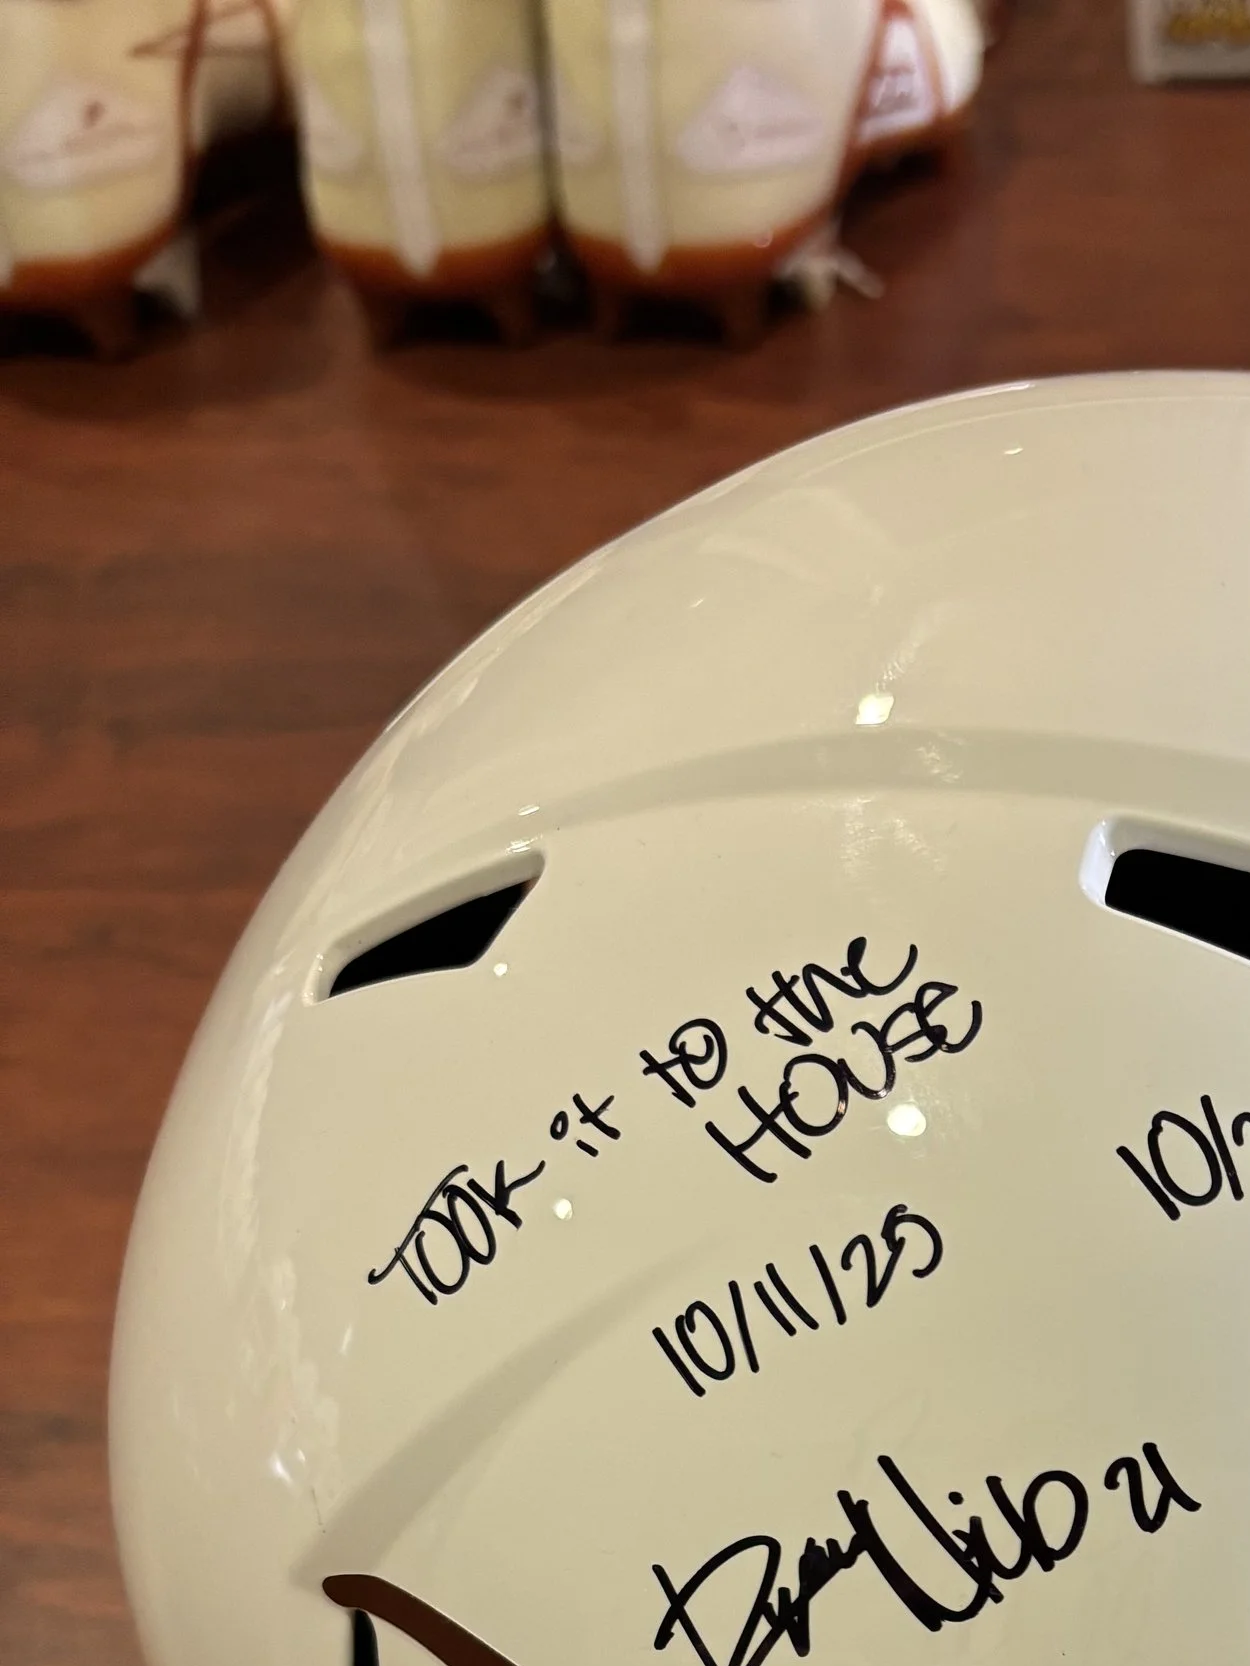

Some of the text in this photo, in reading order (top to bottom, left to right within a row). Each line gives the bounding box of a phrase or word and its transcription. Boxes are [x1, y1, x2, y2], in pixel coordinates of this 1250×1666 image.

[549, 1093, 621, 1158] it
[745, 936, 918, 1047] the
[651, 1203, 944, 1398] 10/11/25
